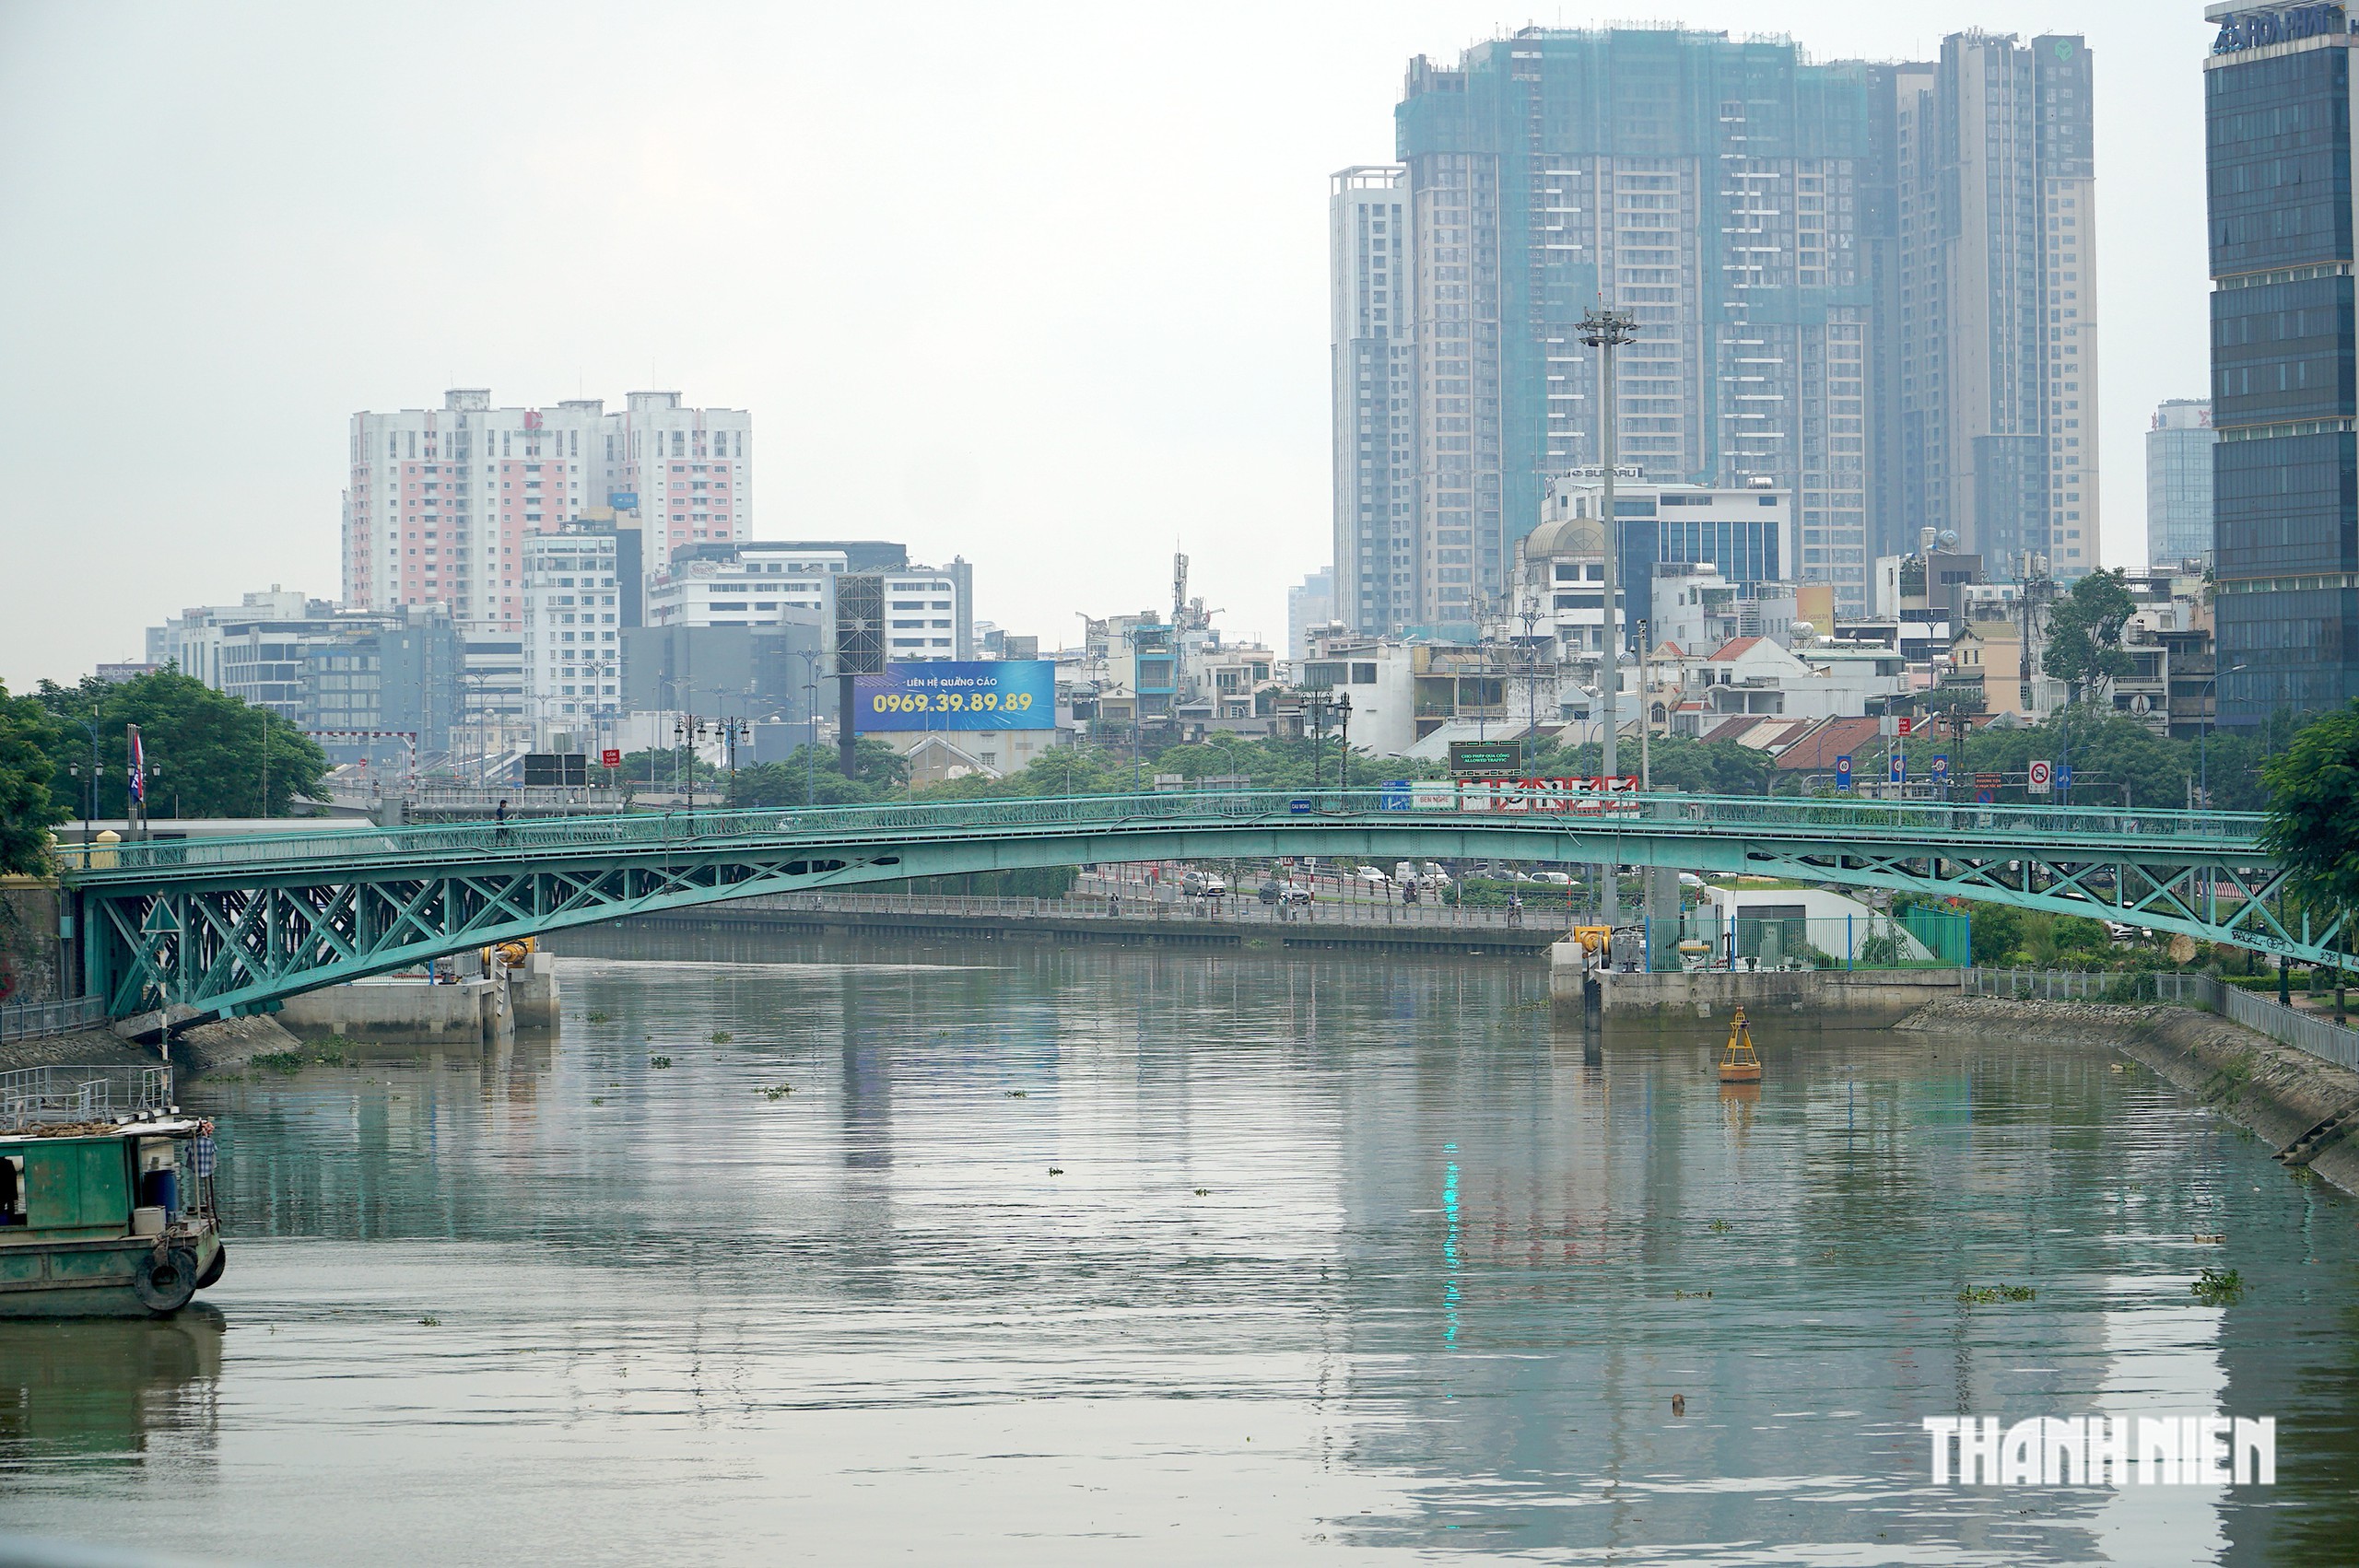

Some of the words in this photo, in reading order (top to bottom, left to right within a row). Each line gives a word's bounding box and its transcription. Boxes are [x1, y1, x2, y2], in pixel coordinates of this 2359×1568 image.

[1585, 469, 1636, 477] SUARU
[907, 677, 925, 687] LIÊN
[927, 677, 938, 689] HỆ
[976, 675, 998, 686] CÁO
[873, 693, 1033, 713] 0969.39.89.89
